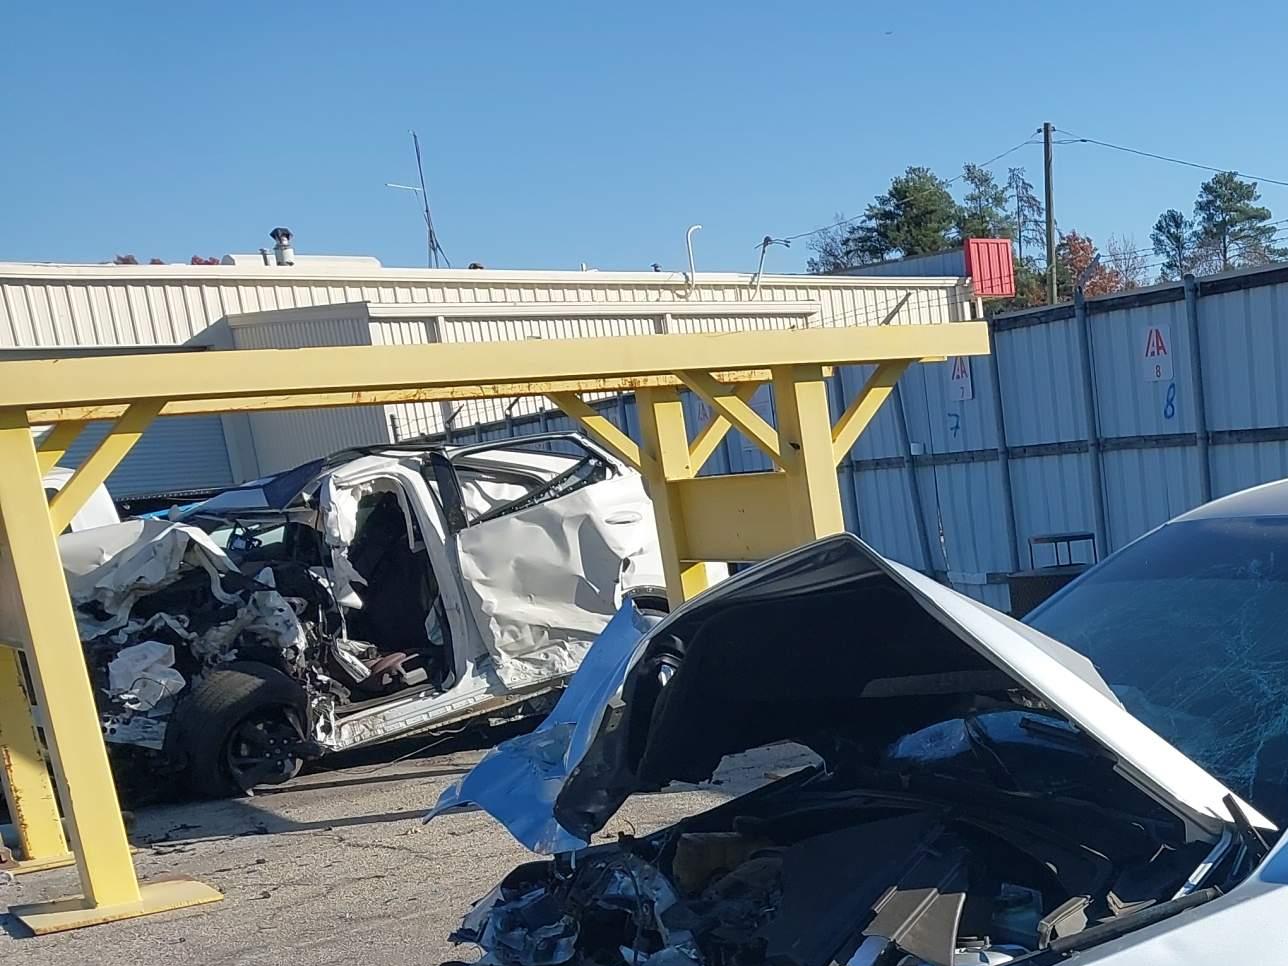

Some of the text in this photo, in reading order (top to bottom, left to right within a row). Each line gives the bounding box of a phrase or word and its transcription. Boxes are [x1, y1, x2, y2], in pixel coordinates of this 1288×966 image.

[1155, 364, 1162, 378] 8
[1163, 382, 1176, 419] 8
[947, 412, 960, 438] 7
